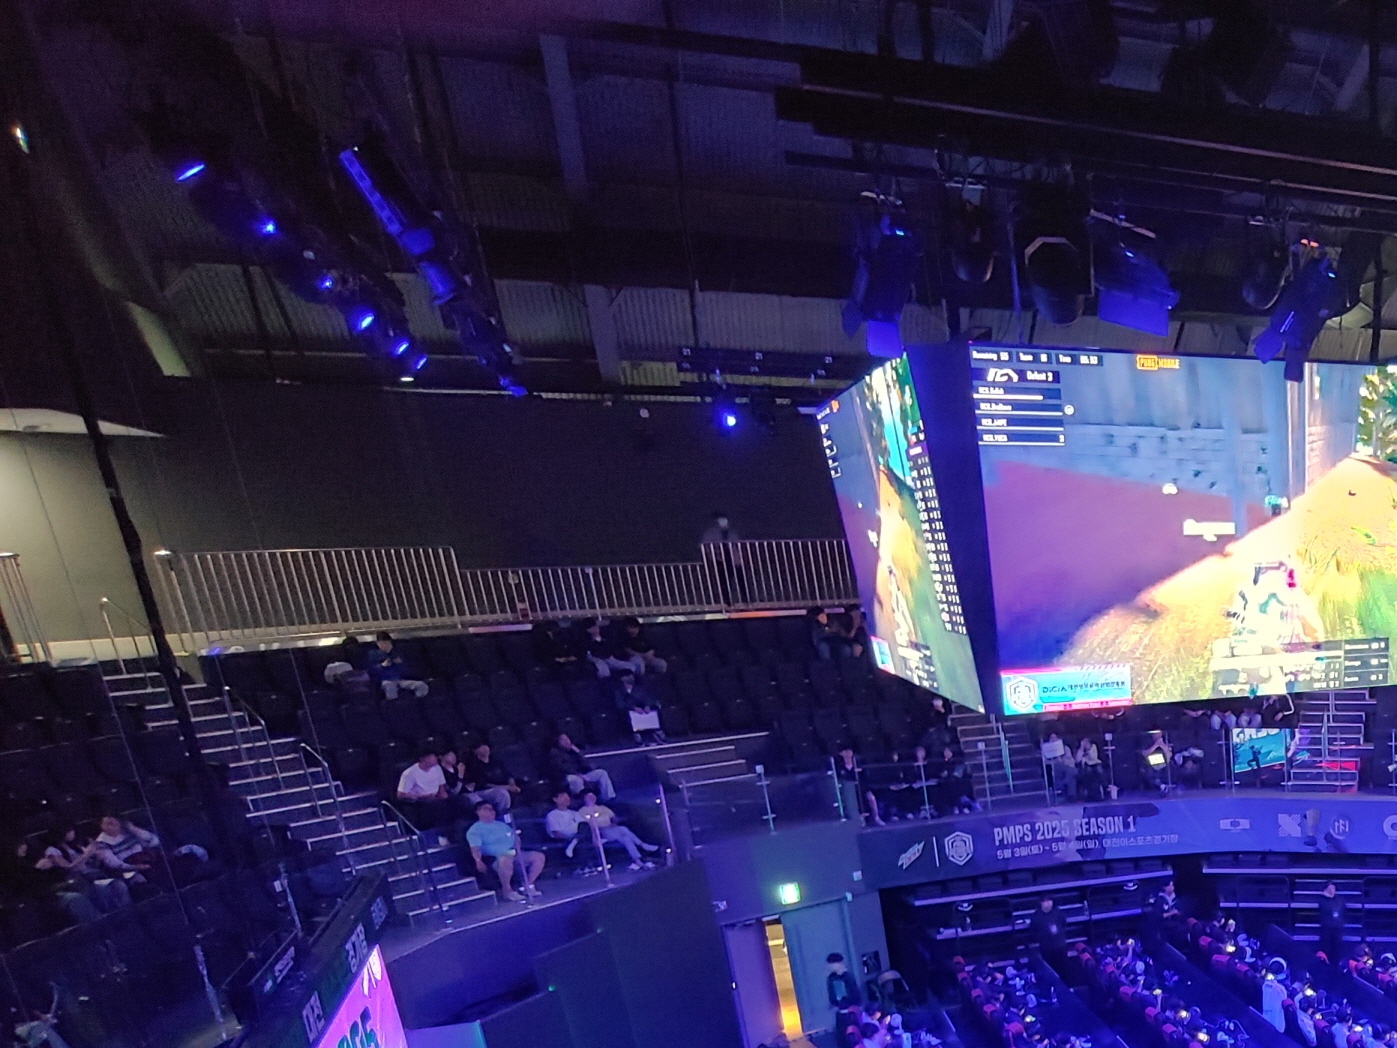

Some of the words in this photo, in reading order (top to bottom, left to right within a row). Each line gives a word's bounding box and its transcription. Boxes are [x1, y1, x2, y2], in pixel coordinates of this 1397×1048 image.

[994, 823, 1032, 847] PMPS
[1035, 819, 1070, 841] 2025
[1073, 814, 1125, 837] SEASON
[1127, 814, 1137, 833] 1
